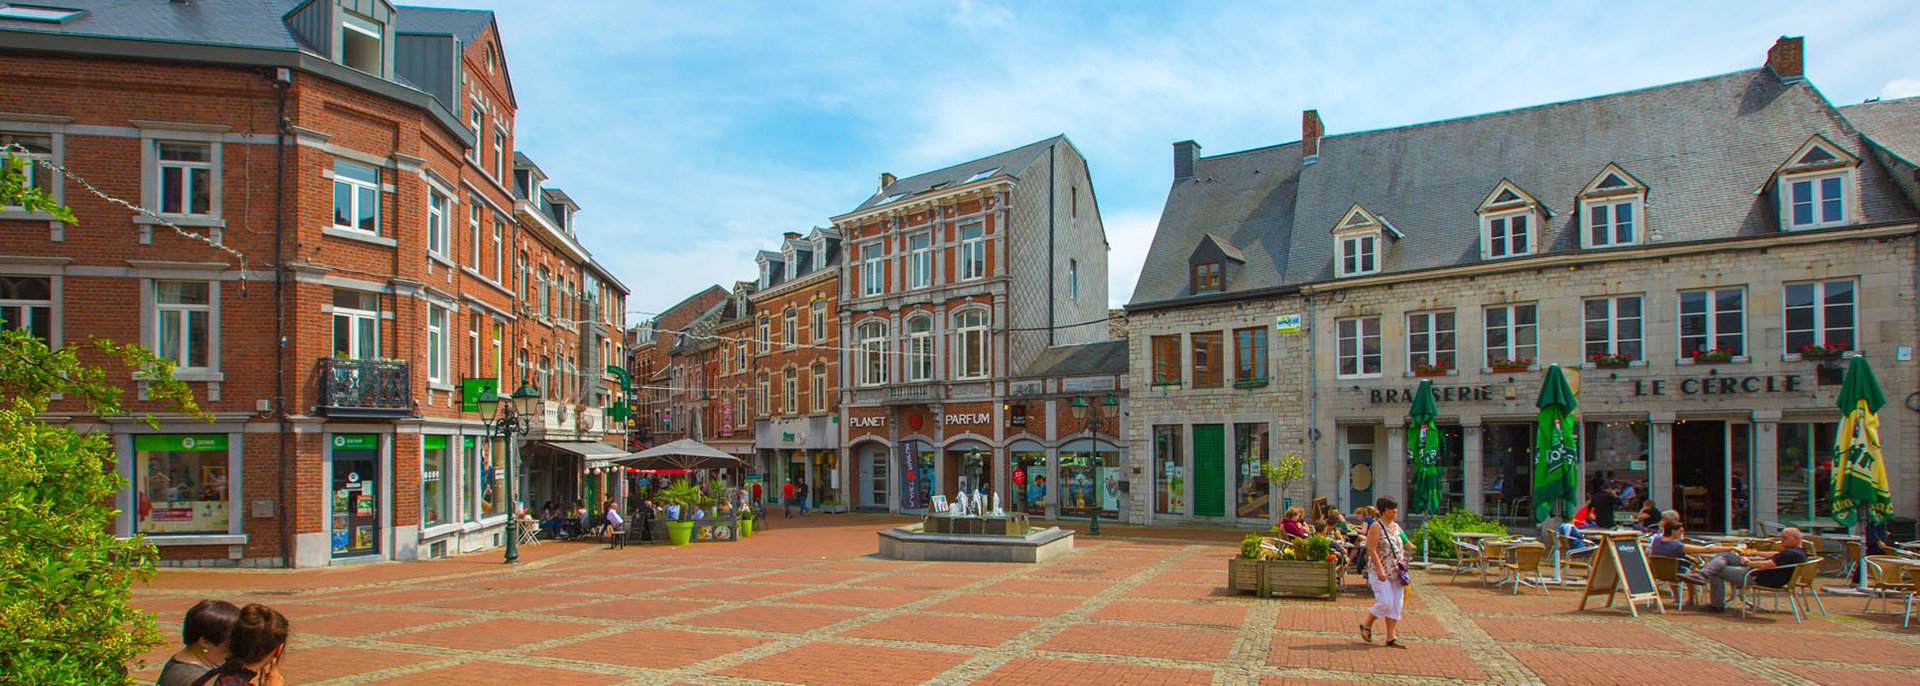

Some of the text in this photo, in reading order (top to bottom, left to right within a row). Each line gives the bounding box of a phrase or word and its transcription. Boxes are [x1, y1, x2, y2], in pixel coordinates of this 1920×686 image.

[1370, 384, 1494, 404] BRASERIE
[1634, 375, 1802, 396] LE CERCLE
[849, 413, 990, 427] PLANET PARFUM
